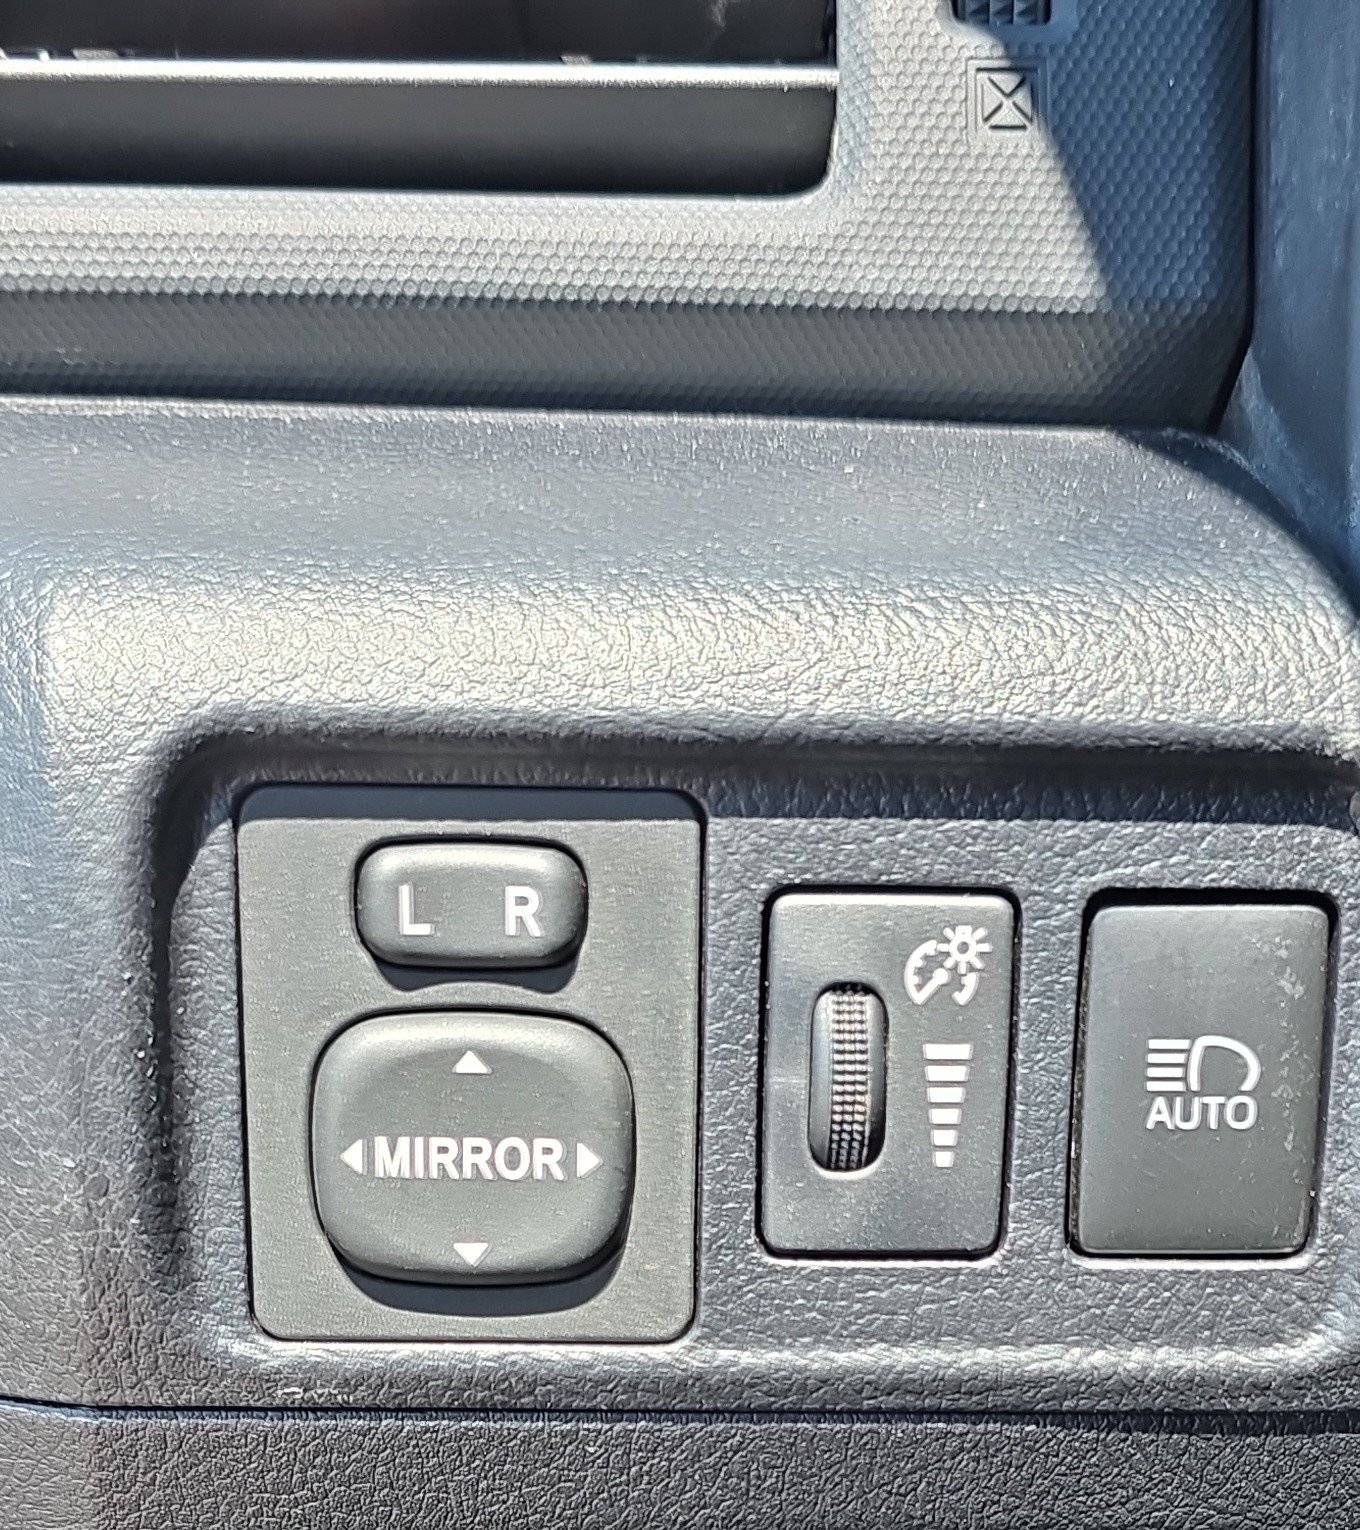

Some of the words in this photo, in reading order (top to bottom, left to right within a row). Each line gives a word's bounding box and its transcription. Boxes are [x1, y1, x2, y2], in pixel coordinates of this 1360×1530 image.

[398, 884, 435, 937] L
[504, 885, 545, 938] R
[1145, 1096, 1259, 1131] AUTO
[374, 1136, 568, 1180] MIRROR
